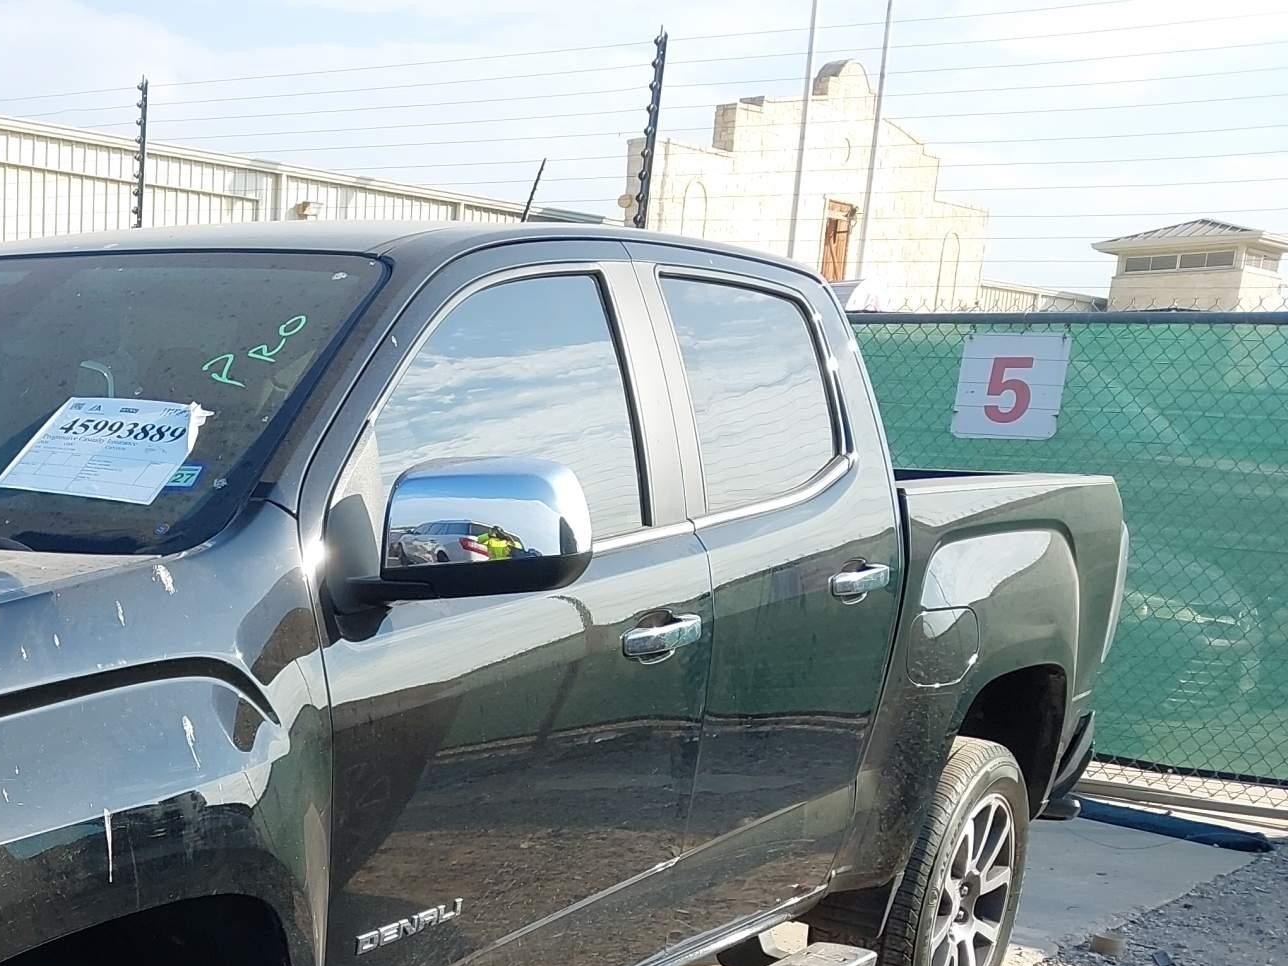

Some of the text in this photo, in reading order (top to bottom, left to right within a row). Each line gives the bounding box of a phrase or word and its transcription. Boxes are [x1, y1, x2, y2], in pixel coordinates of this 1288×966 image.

[202, 315, 307, 388] PRO
[984, 356, 1034, 424] 5
[59, 417, 187, 444] 45993889
[171, 472, 196, 484] 27
[355, 897, 464, 956] DENALI
